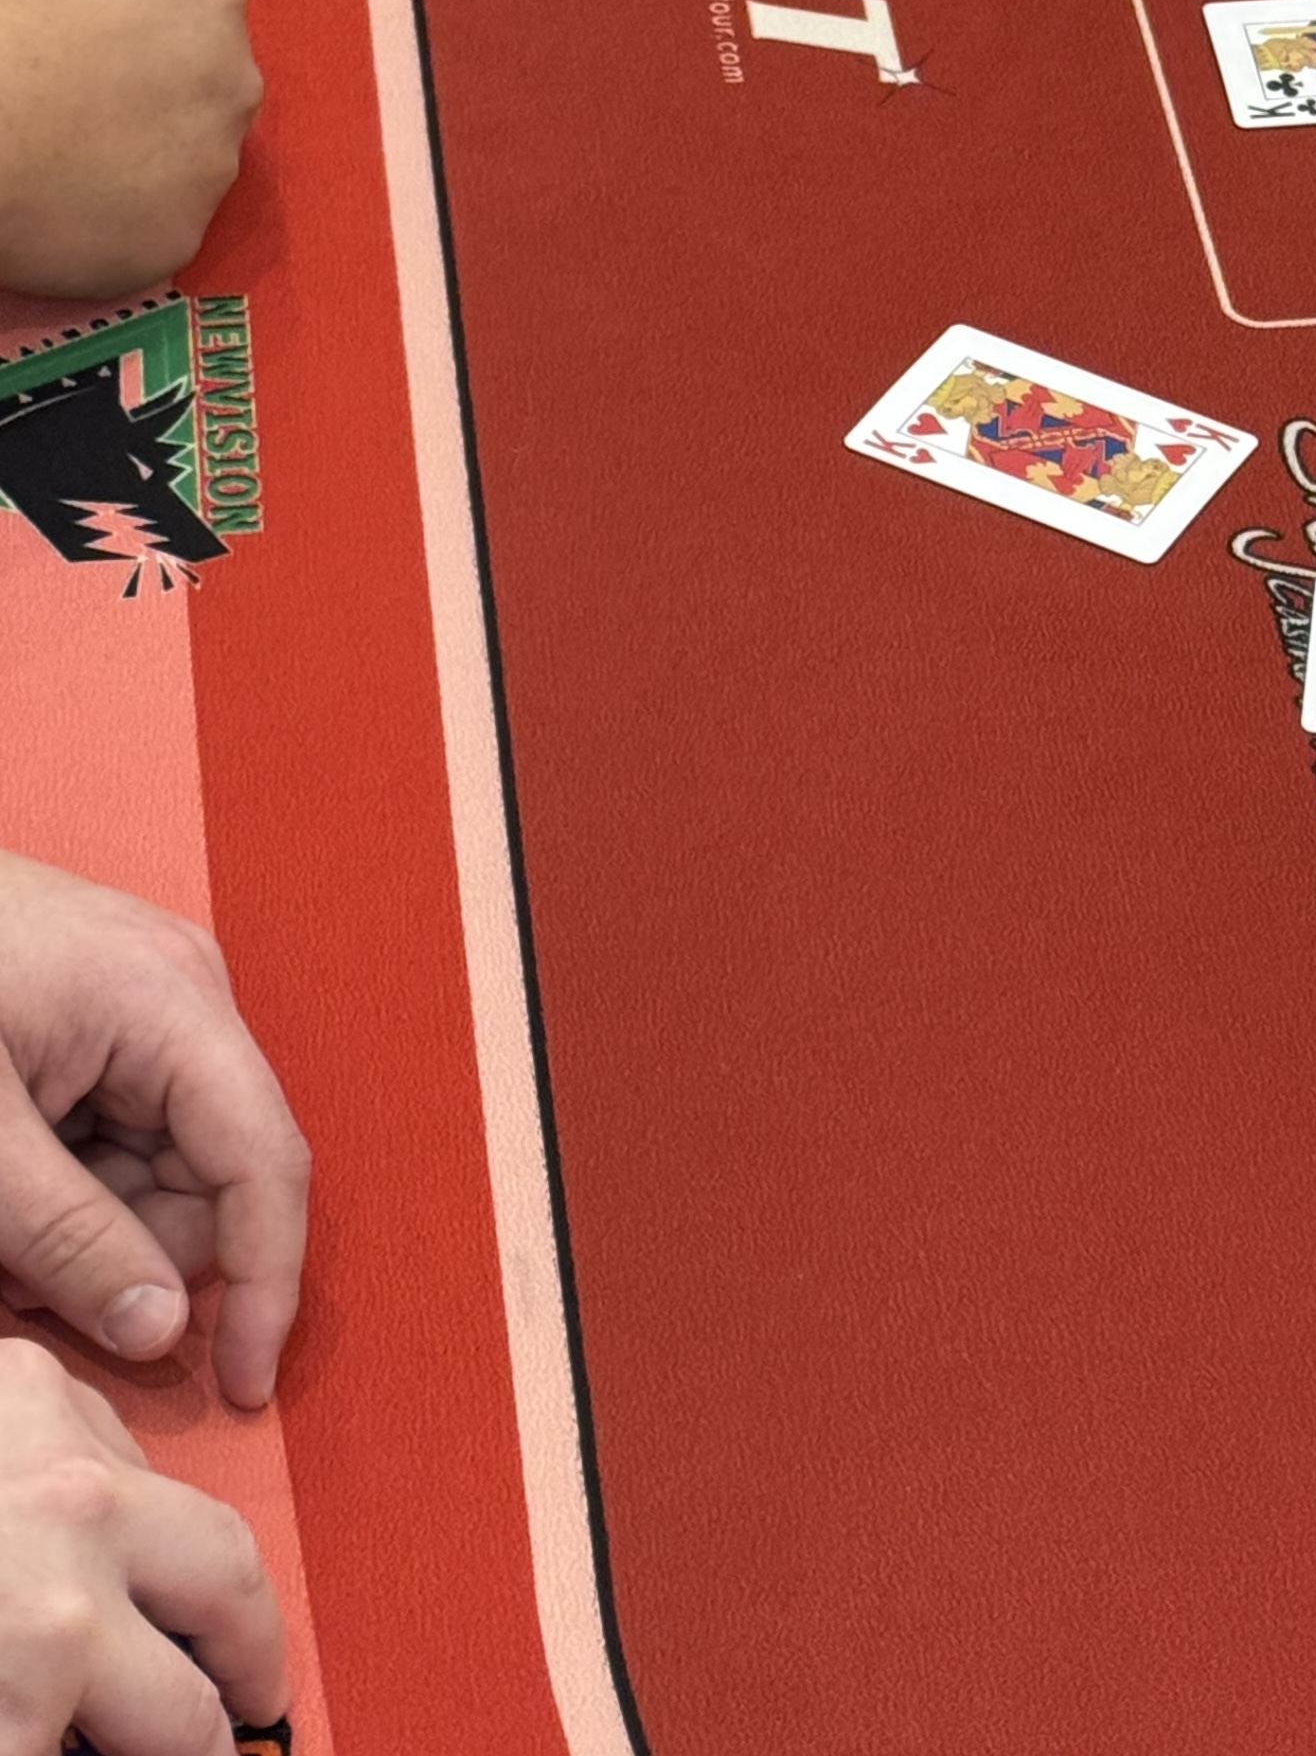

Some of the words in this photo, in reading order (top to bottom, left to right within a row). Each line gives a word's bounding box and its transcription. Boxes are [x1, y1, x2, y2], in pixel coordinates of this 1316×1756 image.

[1248, 103, 1297, 119] K
[864, 429, 917, 458] K
[1187, 423, 1240, 452] K
